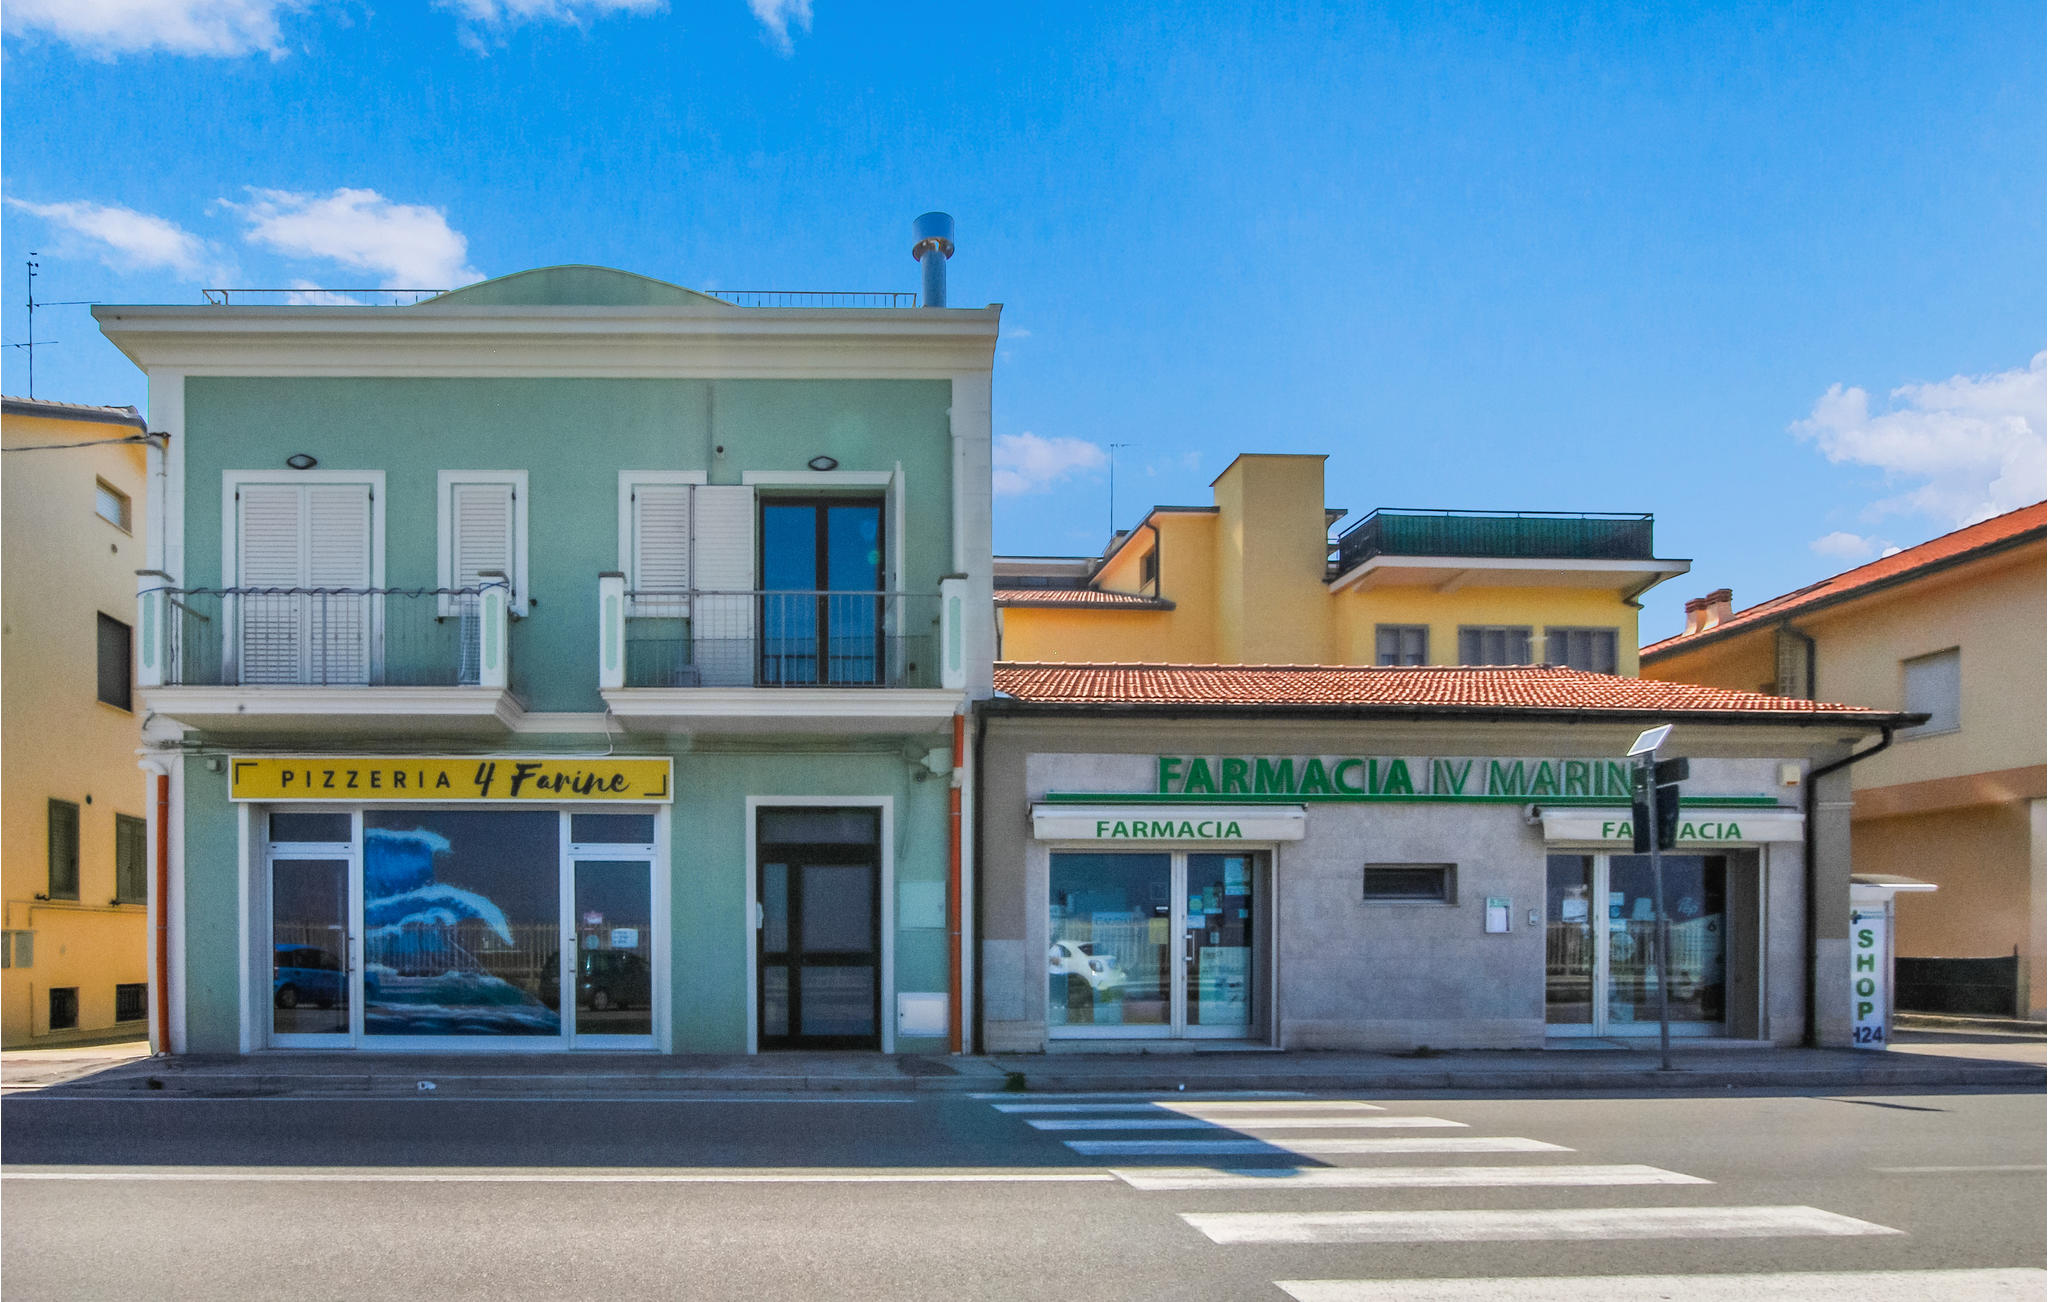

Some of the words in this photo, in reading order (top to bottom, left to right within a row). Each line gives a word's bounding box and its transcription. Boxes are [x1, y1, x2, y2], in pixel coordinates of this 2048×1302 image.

[281, 770, 451, 789] PIZZERIA
[474, 762, 496, 797] 4
[510, 762, 630, 797] Farine
[1157, 757, 1415, 794] FARMACIA
[1431, 759, 1472, 795] IV
[1488, 760, 1642, 796] MARIN
[1096, 821, 1242, 838] FARMACIA
[1602, 822, 1742, 839] FAACIA
[1856, 929, 1875, 1021] SHOP
